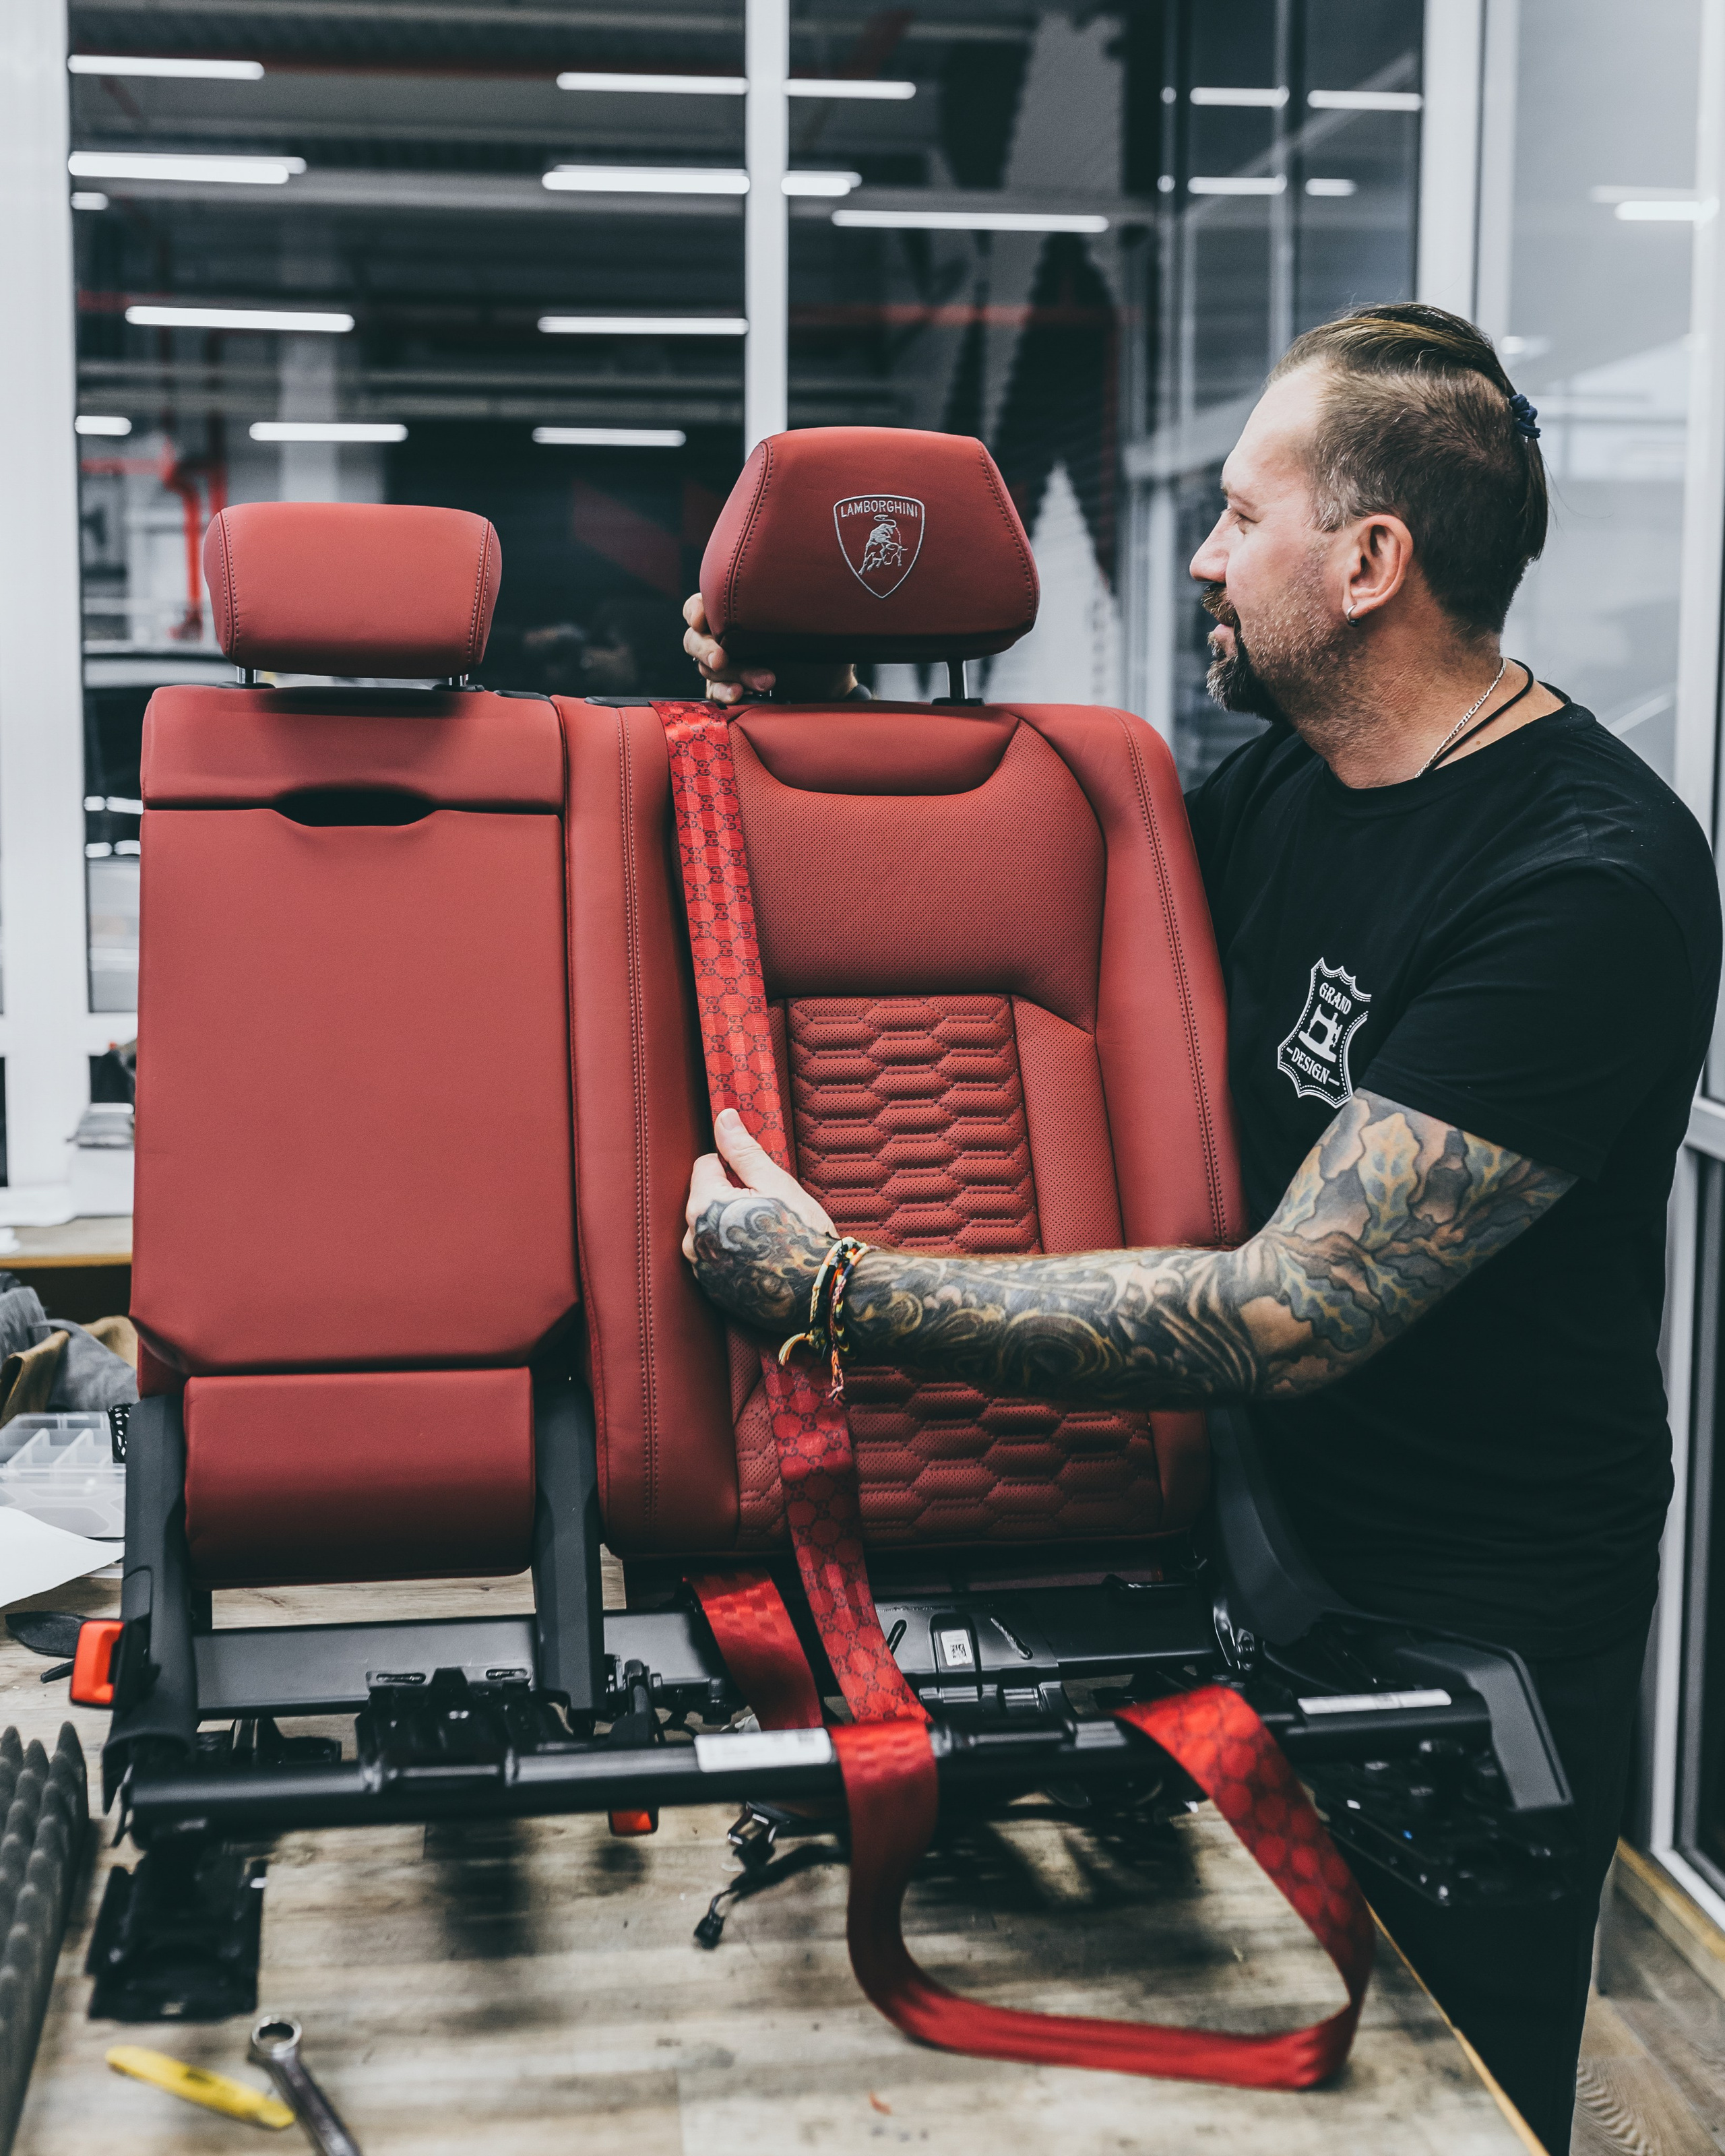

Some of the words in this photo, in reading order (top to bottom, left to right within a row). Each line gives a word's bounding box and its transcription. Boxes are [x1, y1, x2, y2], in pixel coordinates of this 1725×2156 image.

[840, 500, 918, 517] LAMBORGHINI
[1319, 982, 1352, 1015] GRAND
[1291, 1046, 1331, 1085] DESIGN
